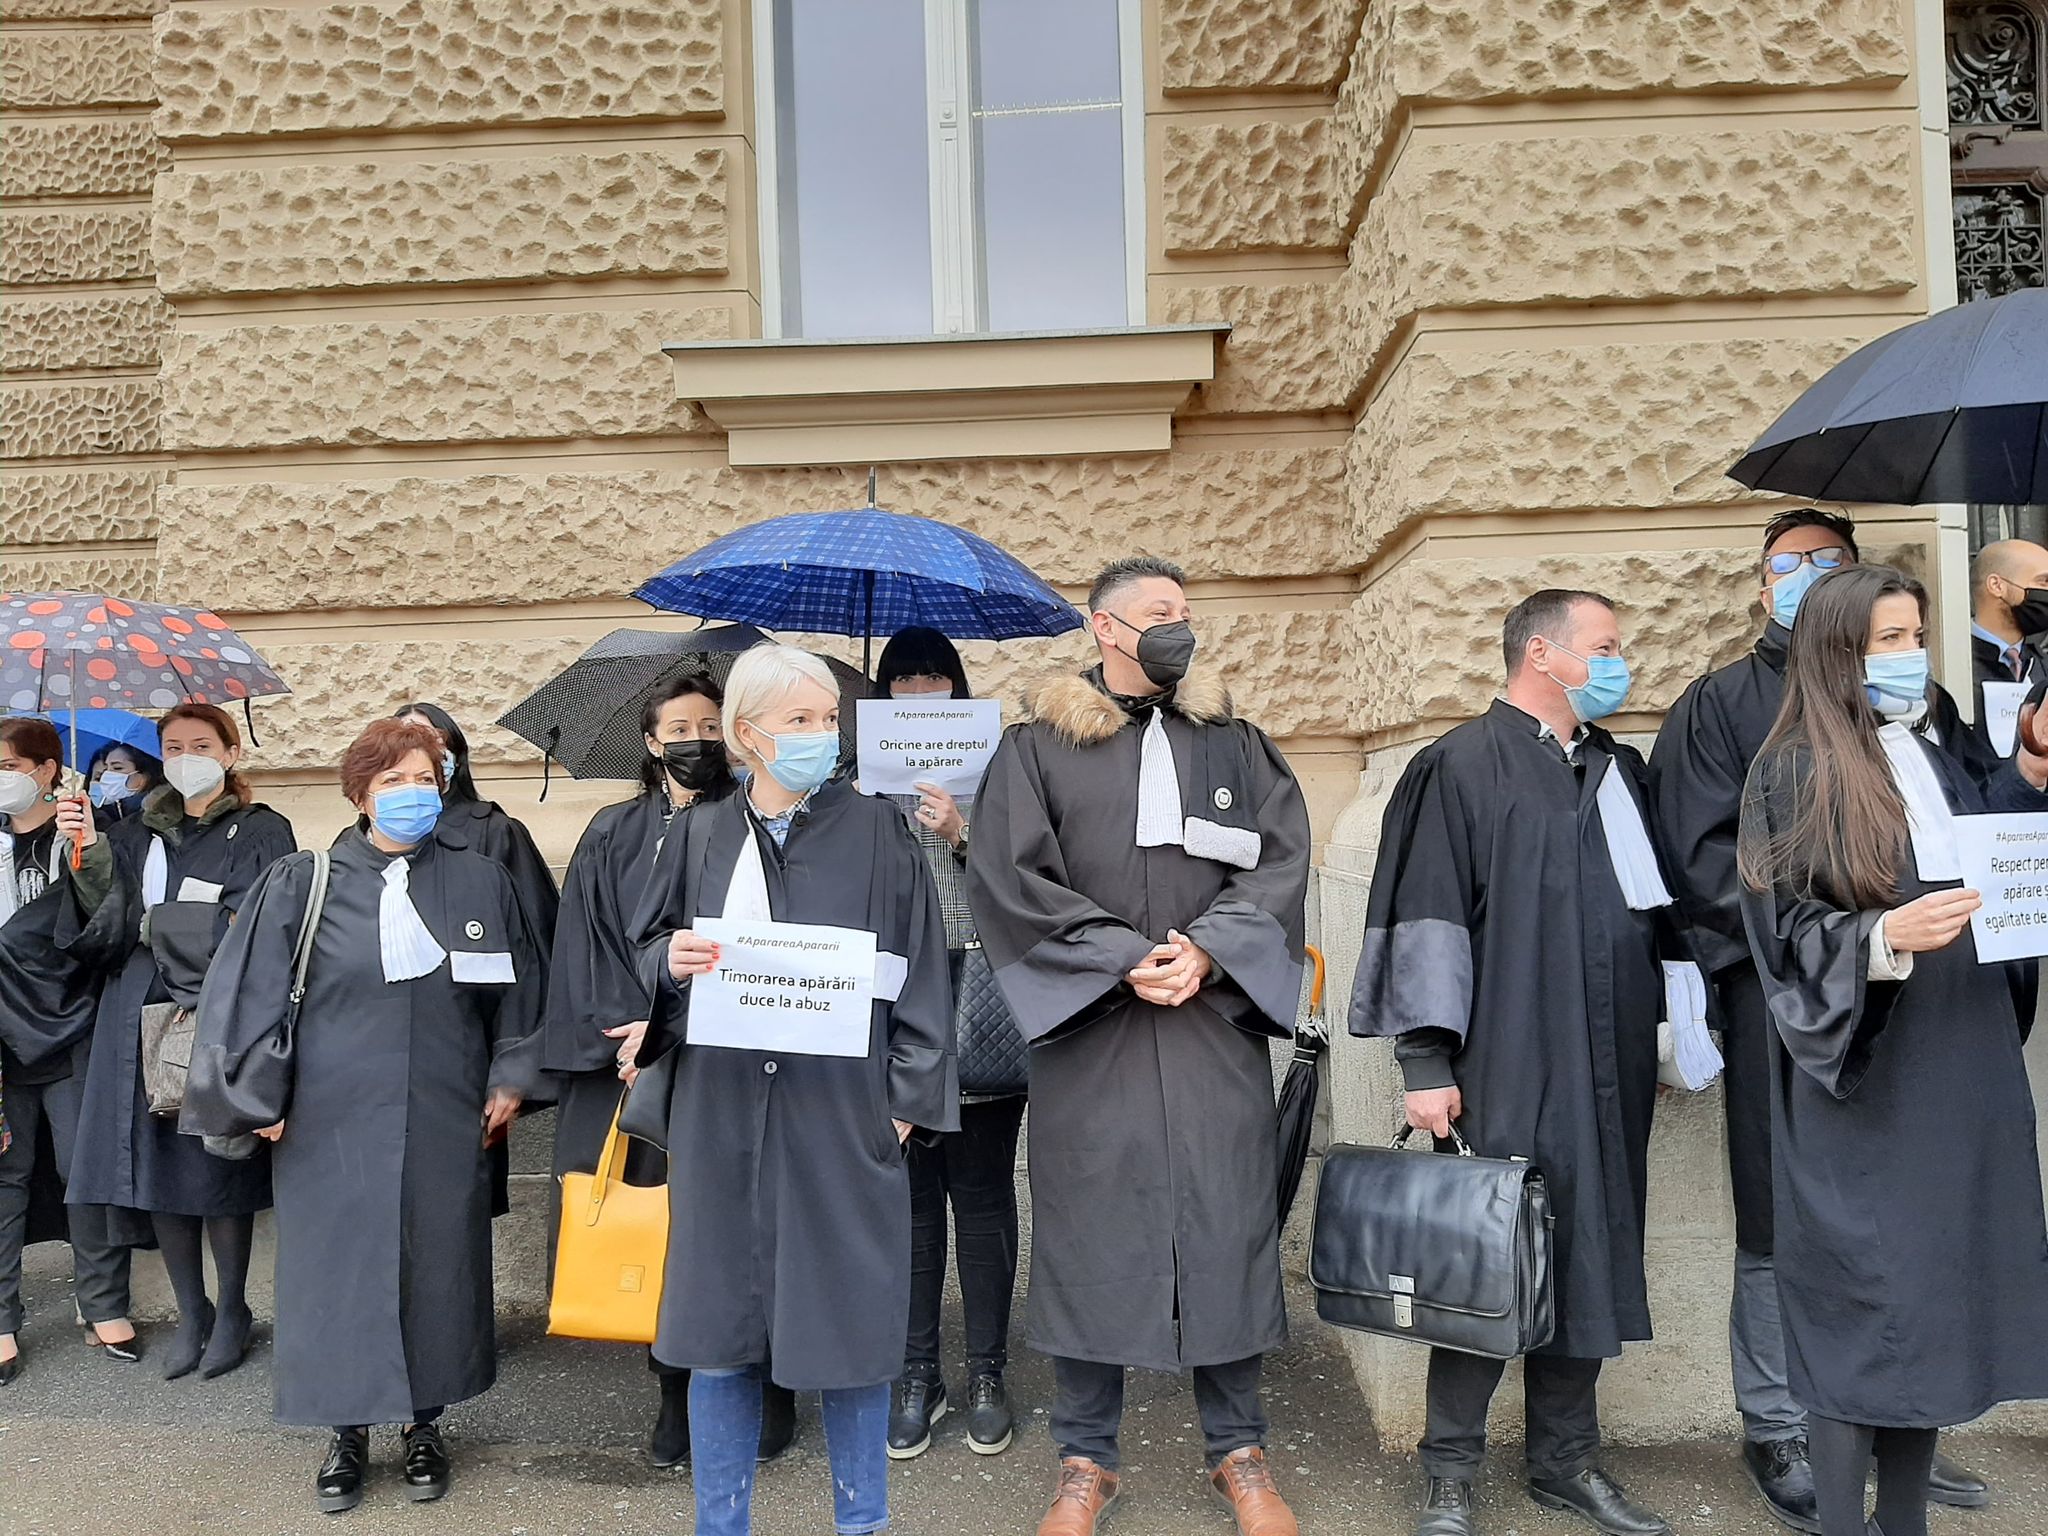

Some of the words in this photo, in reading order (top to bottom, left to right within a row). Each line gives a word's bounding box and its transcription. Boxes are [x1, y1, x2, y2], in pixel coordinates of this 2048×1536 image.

[894, 710, 974, 720] #AparareaApararii
[879, 739, 922, 751] Oricine
[925, 741, 944, 750] are
[946, 739, 988, 752] dreptul
[905, 756, 916, 767] la
[918, 757, 963, 769] apărare
[1991, 857, 2031, 877] Respect
[2003, 882, 2042, 904] apărare
[1985, 911, 2031, 934] egalitate
[2033, 907, 2048, 924] de
[737, 936, 840, 951] #AparareaApararii
[719, 968, 795, 987] Timorarea
[799, 976, 856, 992] apărării
[739, 992, 775, 1007] duce
[779, 994, 791, 1008] la
[795, 996, 831, 1012] abuz
